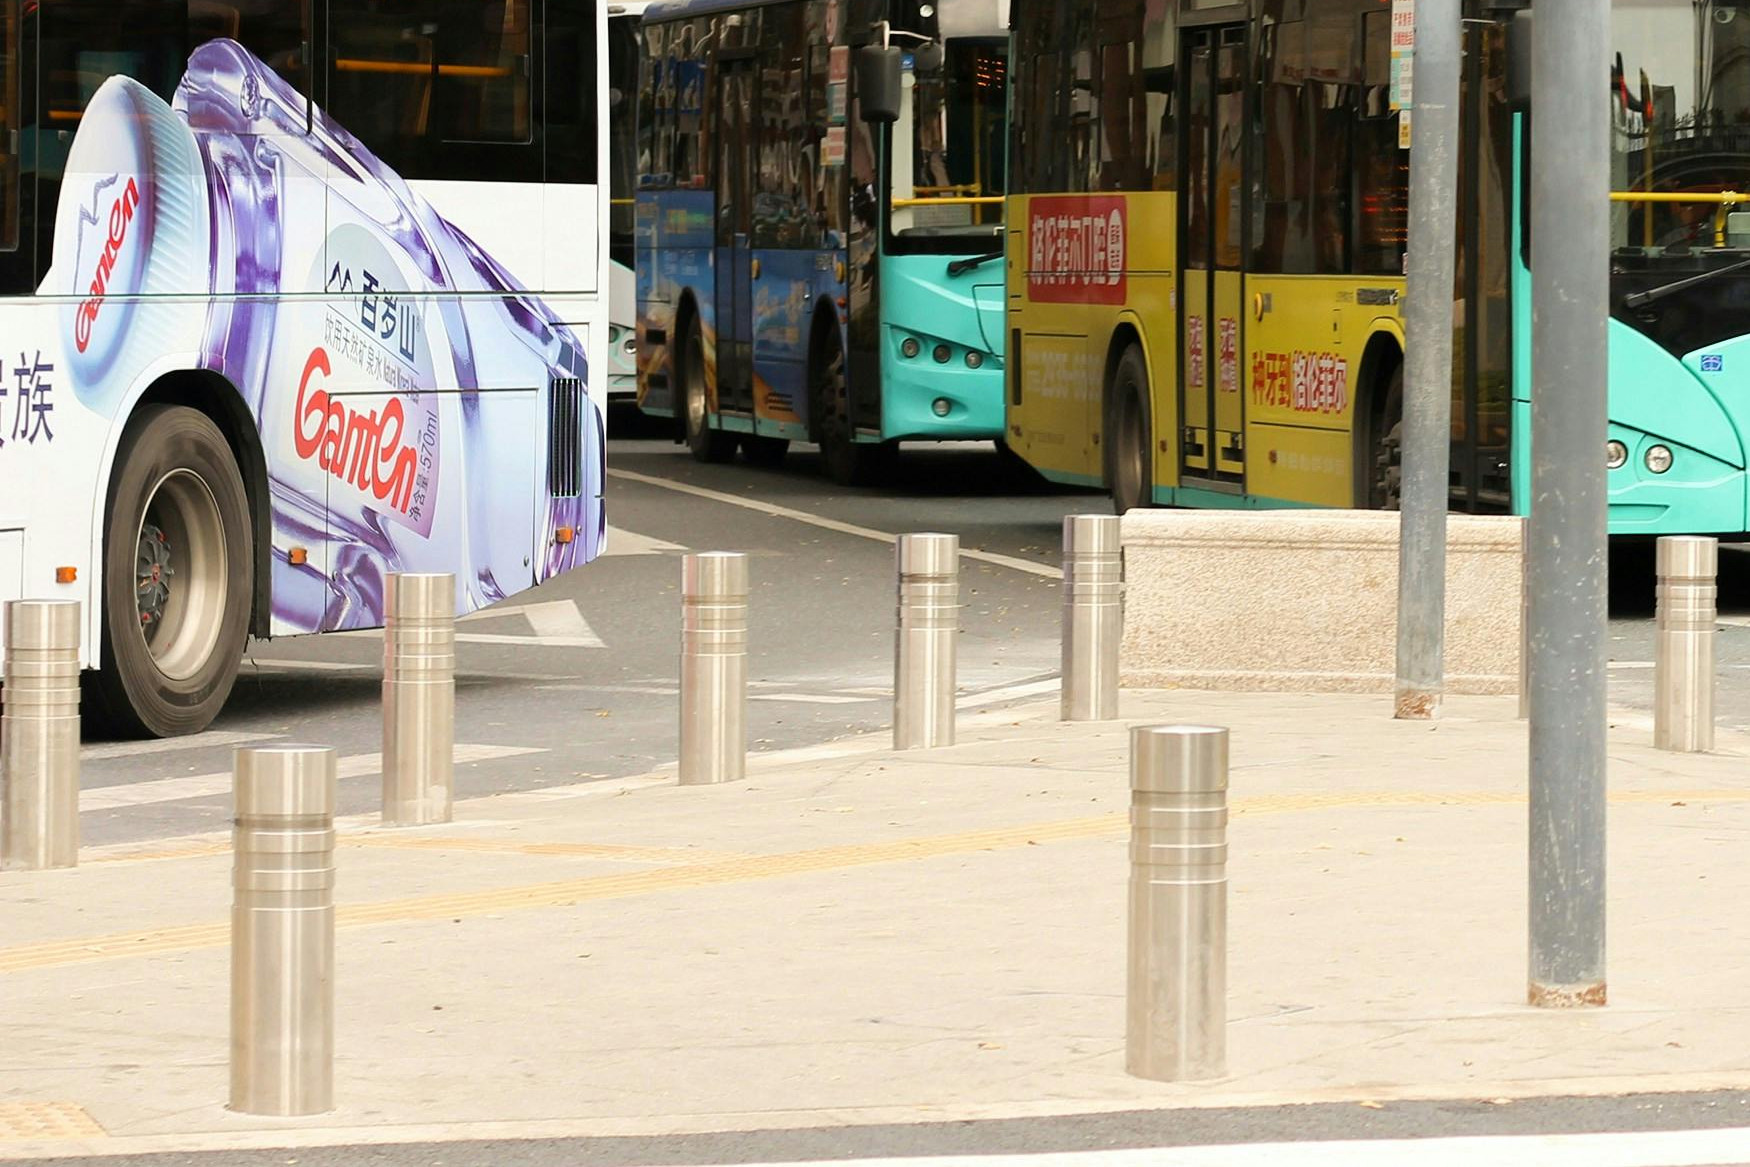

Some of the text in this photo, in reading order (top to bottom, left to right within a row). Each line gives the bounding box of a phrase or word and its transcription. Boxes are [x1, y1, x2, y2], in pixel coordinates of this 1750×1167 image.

[75, 177, 139, 354] Ganten
[361, 269, 415, 362] 百岁山
[294, 347, 417, 514] Ganten
